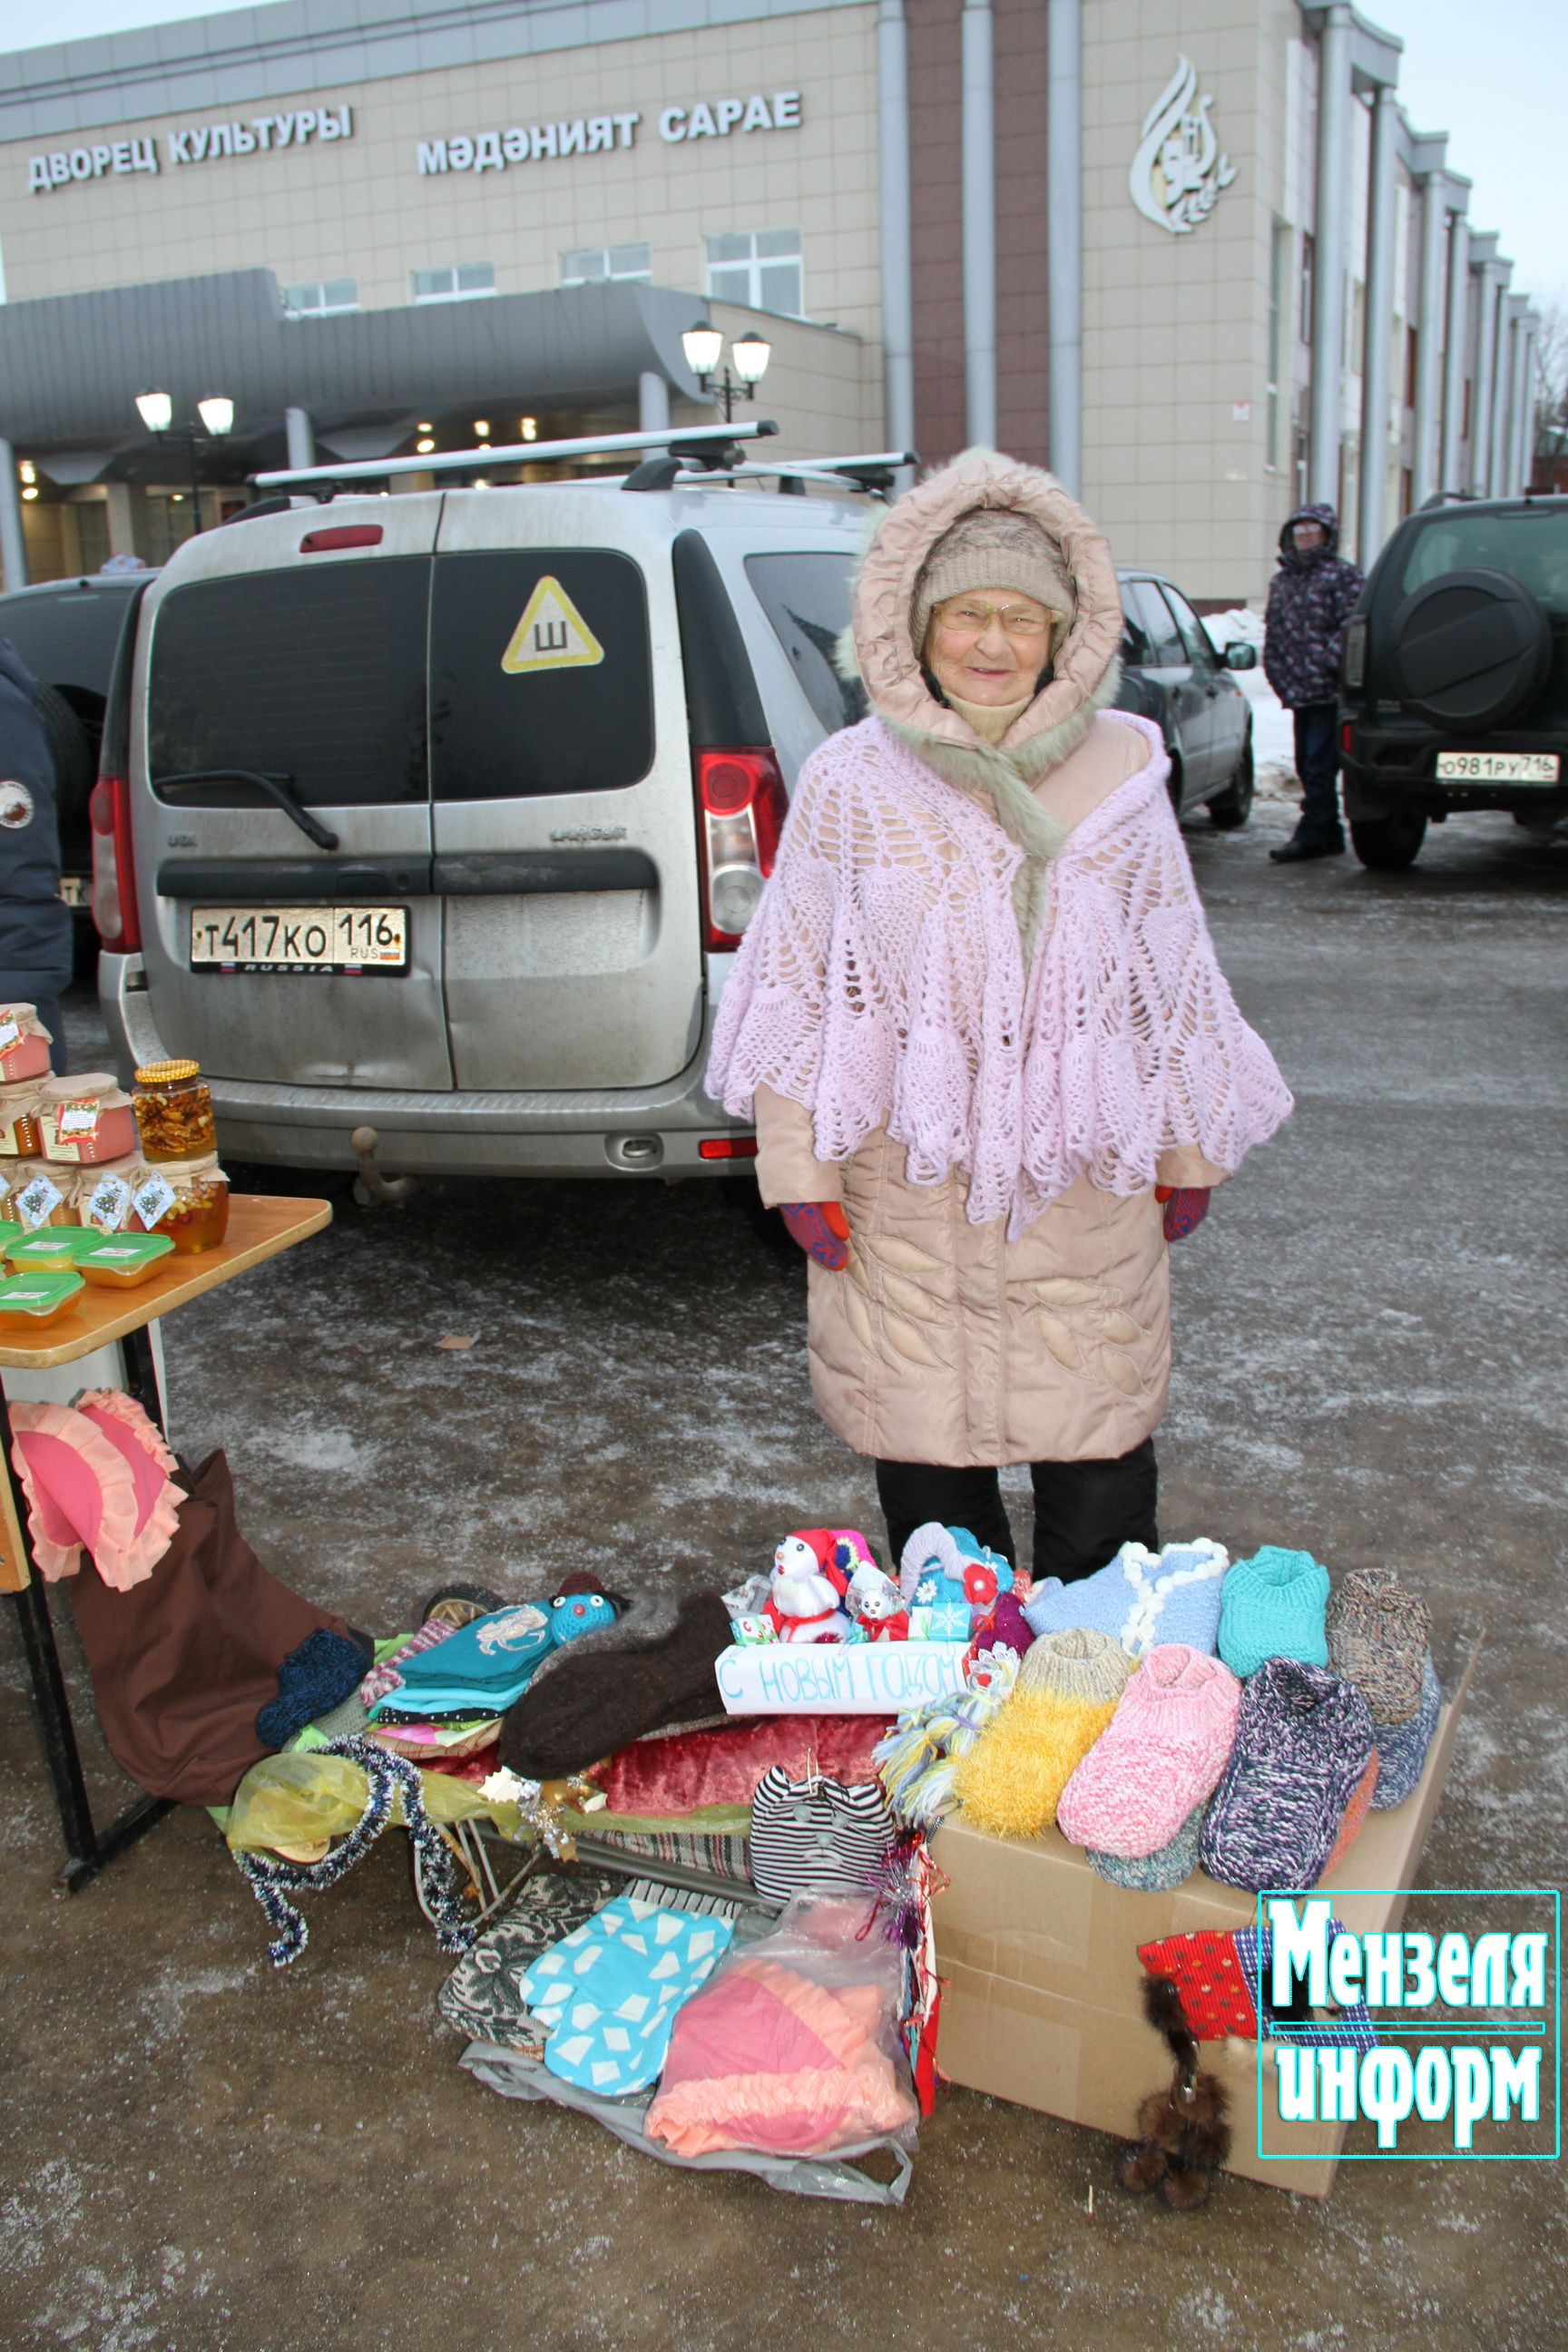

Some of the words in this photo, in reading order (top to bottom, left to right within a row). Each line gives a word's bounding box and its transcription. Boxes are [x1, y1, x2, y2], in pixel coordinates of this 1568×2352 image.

[27, 138, 160, 193] ДВОРЕЦ
[167, 104, 354, 164] КУЛЬТУРЫ
[416, 113, 640, 175] МӘДӘНИЯТ
[659, 92, 802, 143] САРАЕ
[534, 621, 567, 652] Ш
[205, 916, 326, 957] Т417КО
[339, 914, 393, 946] 116
[350, 947, 378, 959] RUS
[244, 964, 334, 973] RUSSIA
[719, 1659, 743, 1699] С
[760, 1654, 856, 1702] НОВЫМ
[865, 1653, 959, 1700] ГОДОМ
